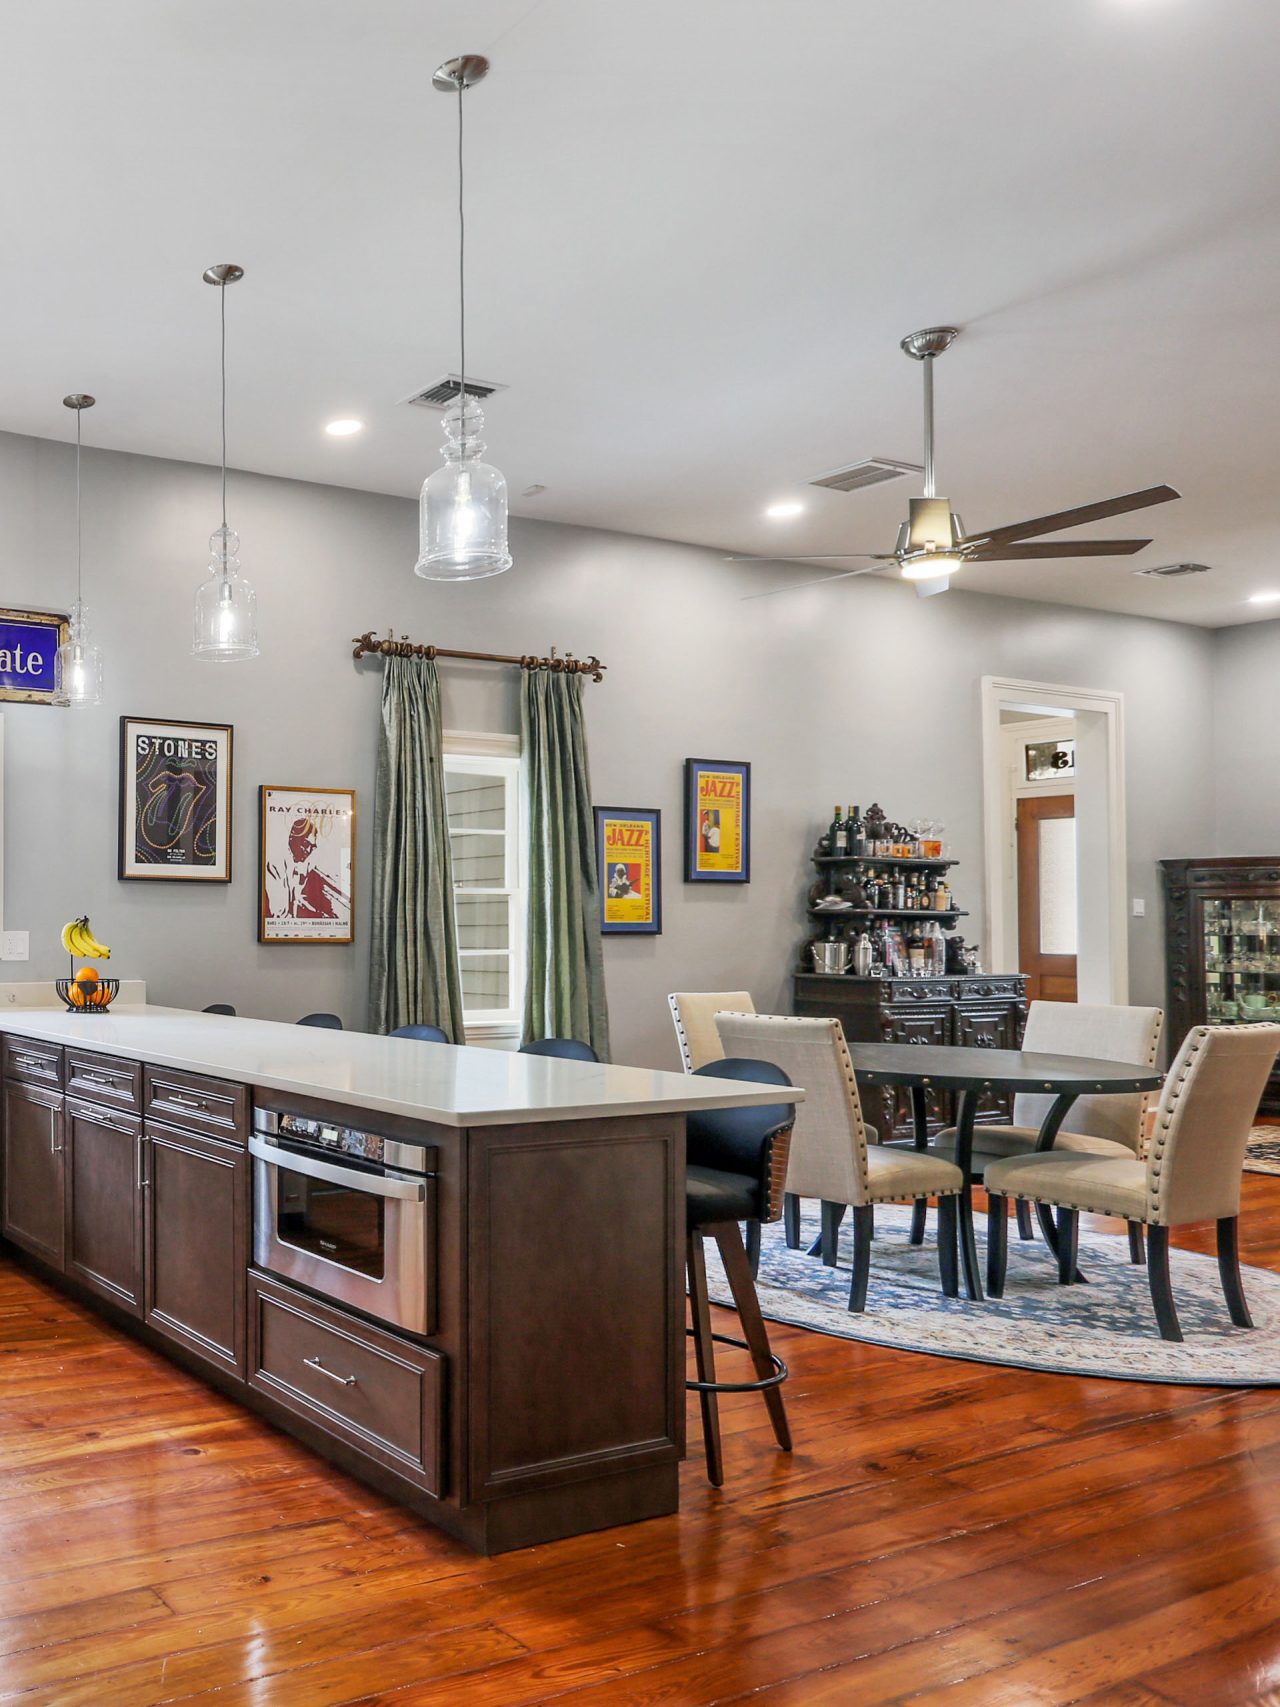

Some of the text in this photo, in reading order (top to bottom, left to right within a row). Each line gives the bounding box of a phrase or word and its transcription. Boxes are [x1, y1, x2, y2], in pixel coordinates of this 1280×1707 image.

[137, 736, 217, 760] STONES
[700, 780, 737, 798] JAZZ
[297, 807, 349, 816] CHARLES
[606, 828, 644, 847] JAZZ
